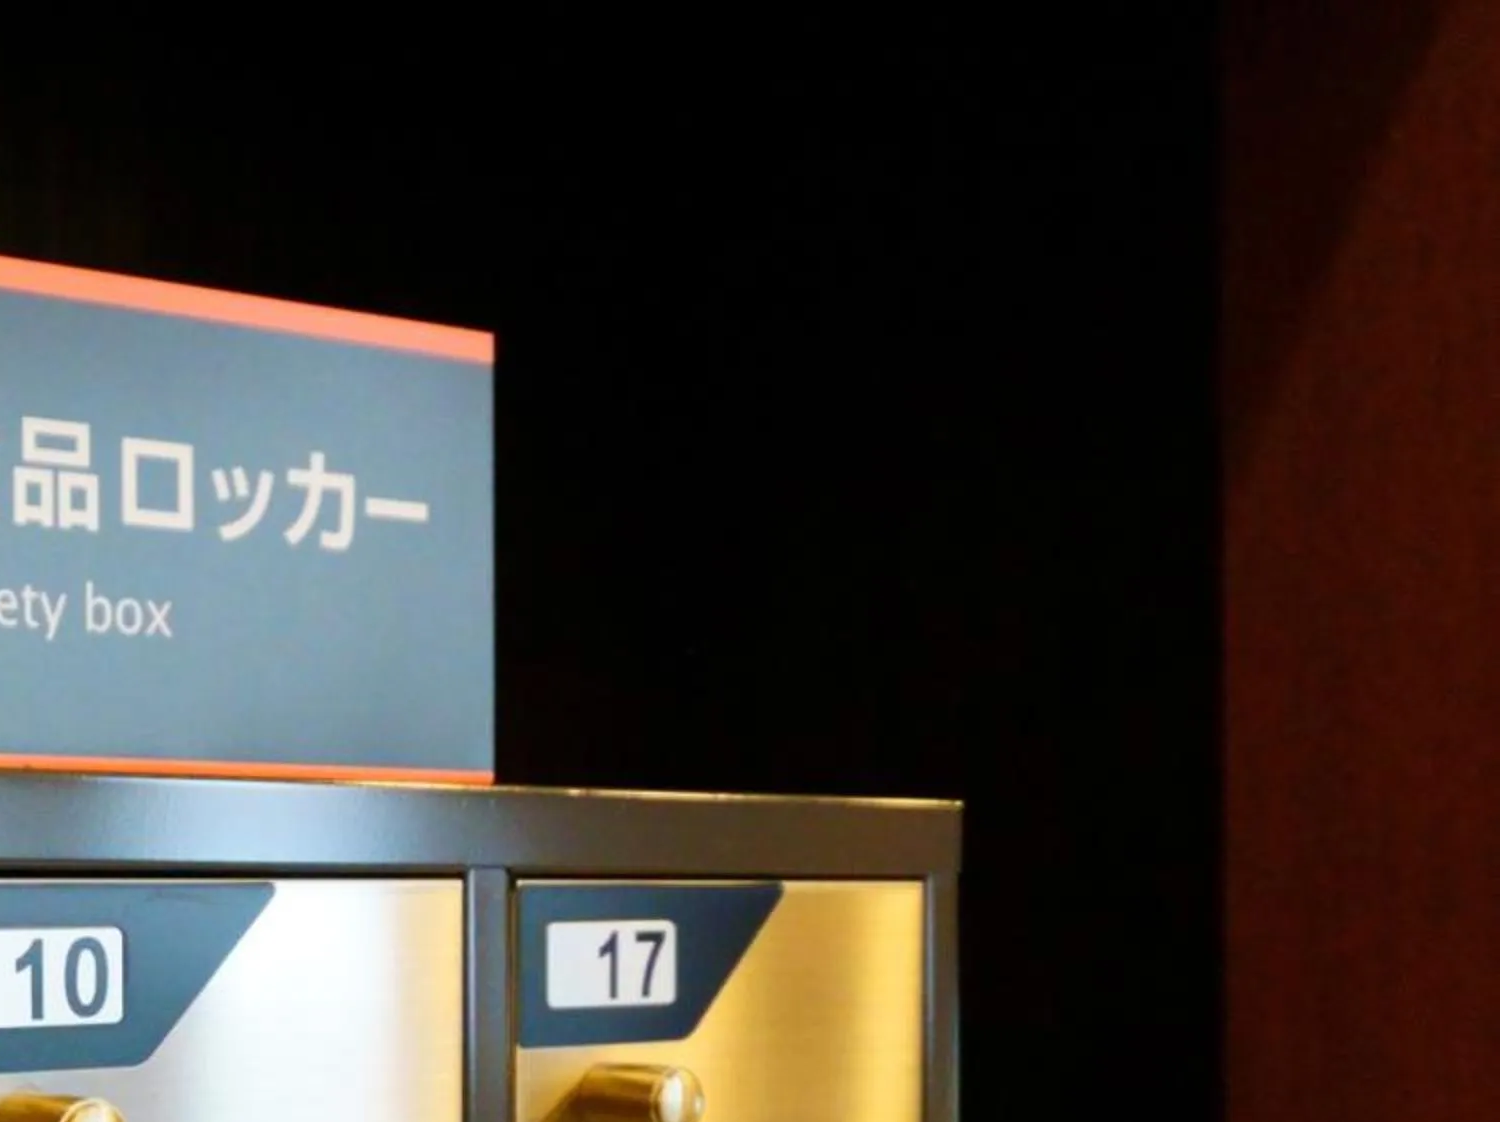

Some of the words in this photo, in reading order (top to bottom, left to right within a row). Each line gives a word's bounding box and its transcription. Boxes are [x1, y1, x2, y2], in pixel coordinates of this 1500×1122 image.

[84, 580, 173, 638] box
[15, 936, 109, 1020] 10
[598, 930, 666, 999] 17
